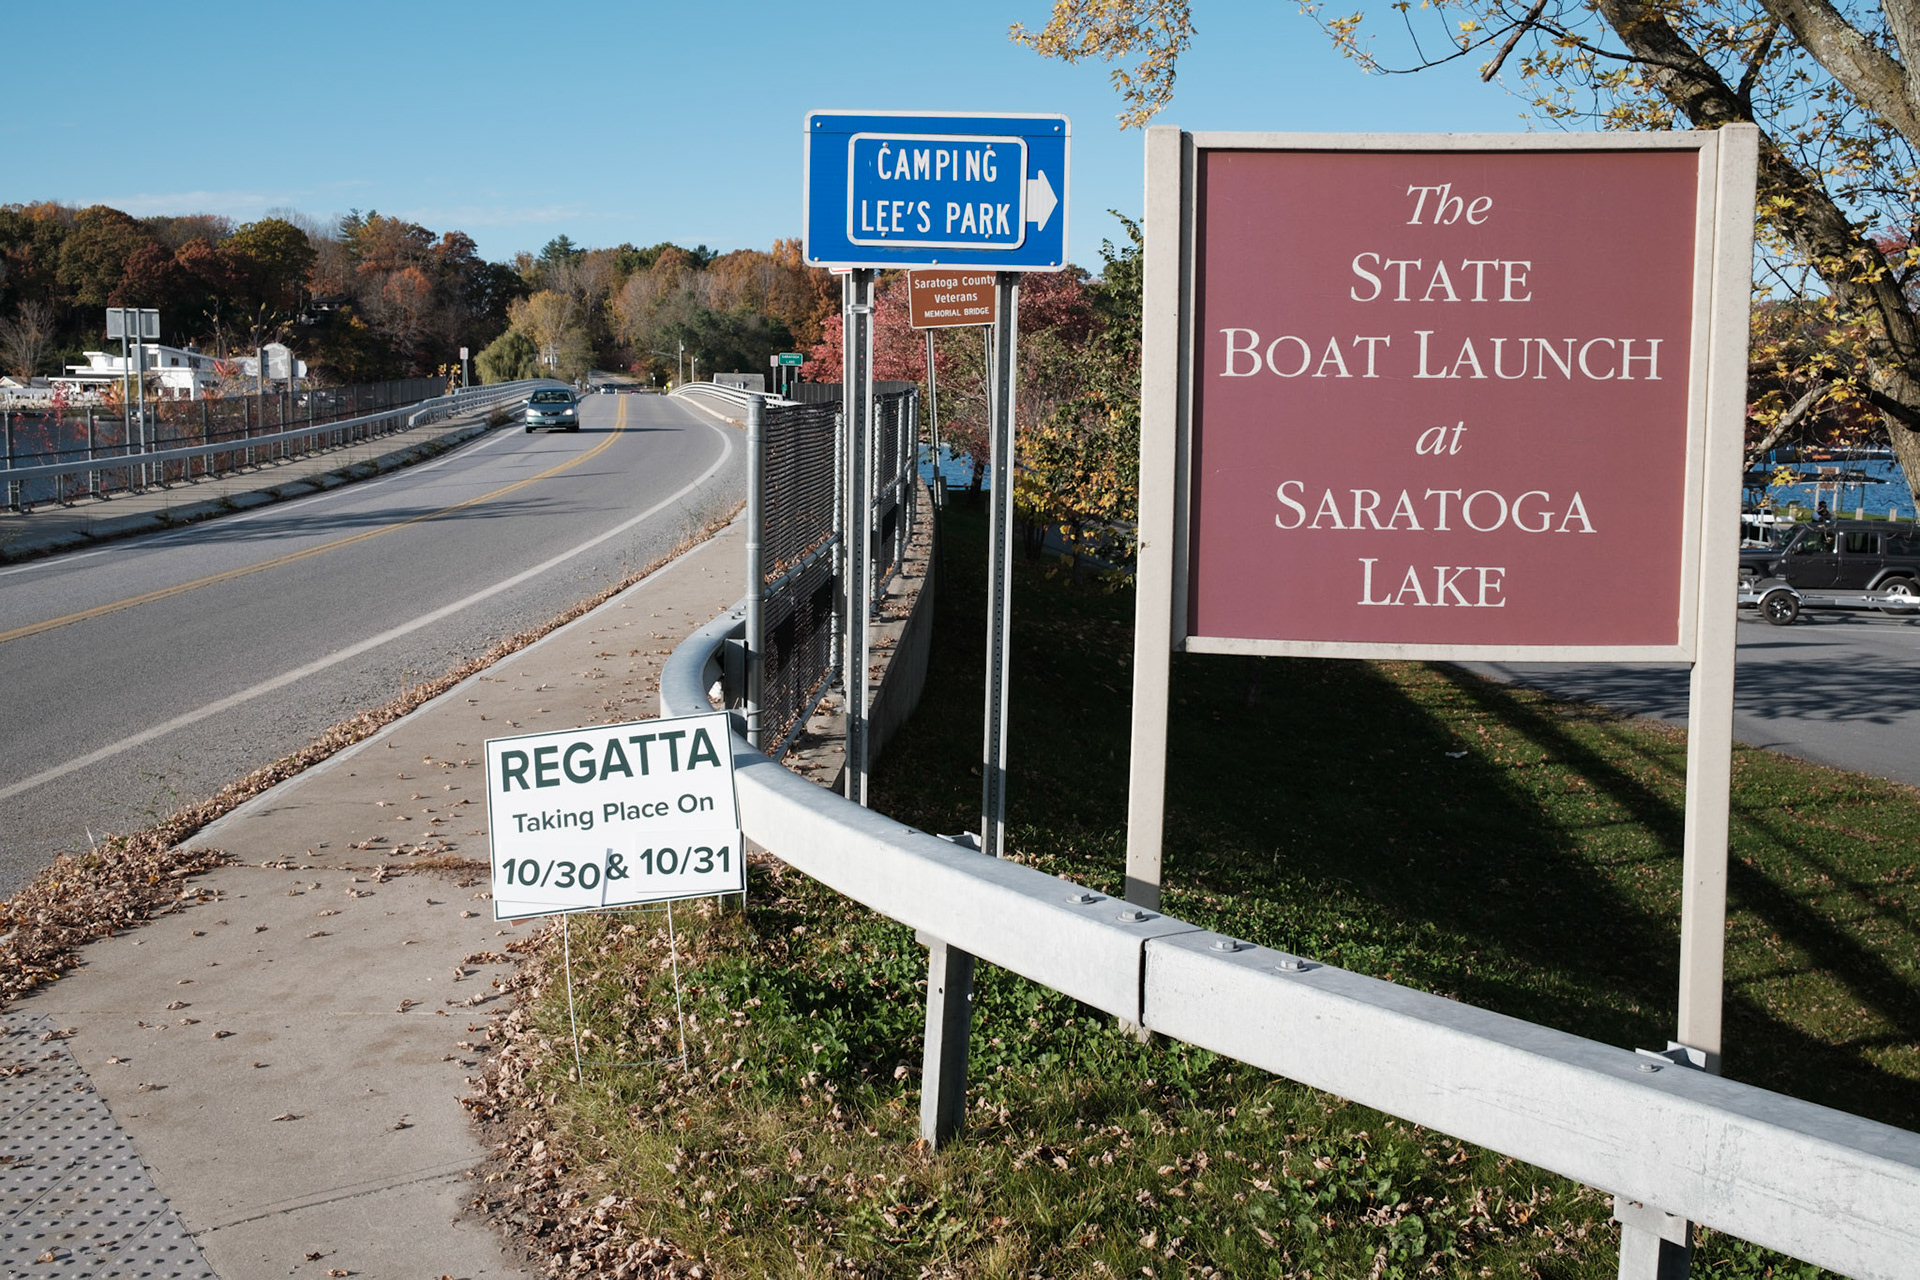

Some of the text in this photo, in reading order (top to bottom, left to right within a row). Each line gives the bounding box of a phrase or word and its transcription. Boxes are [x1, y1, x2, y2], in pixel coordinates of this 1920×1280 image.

[877, 147, 997, 182] CAMPING
[861, 199, 1011, 235] LEE'S PARK
[1406, 182, 1493, 225] The
[914, 275, 996, 290] Saratoga County
[1350, 252, 1532, 302] STATE
[924, 306, 990, 318] MEMORIAL BRIDGE
[934, 293, 978, 304] Veterans
[1219, 327, 1664, 381] BOAT LAUNCH
[1415, 420, 1468, 456] at
[1275, 480, 1598, 533] SARATOGA
[1357, 557, 1506, 608] LAKE
[501, 727, 721, 792] REGATTA
[512, 793, 714, 833] Taking Place On
[502, 845, 730, 890] 10/30 & 10/31
